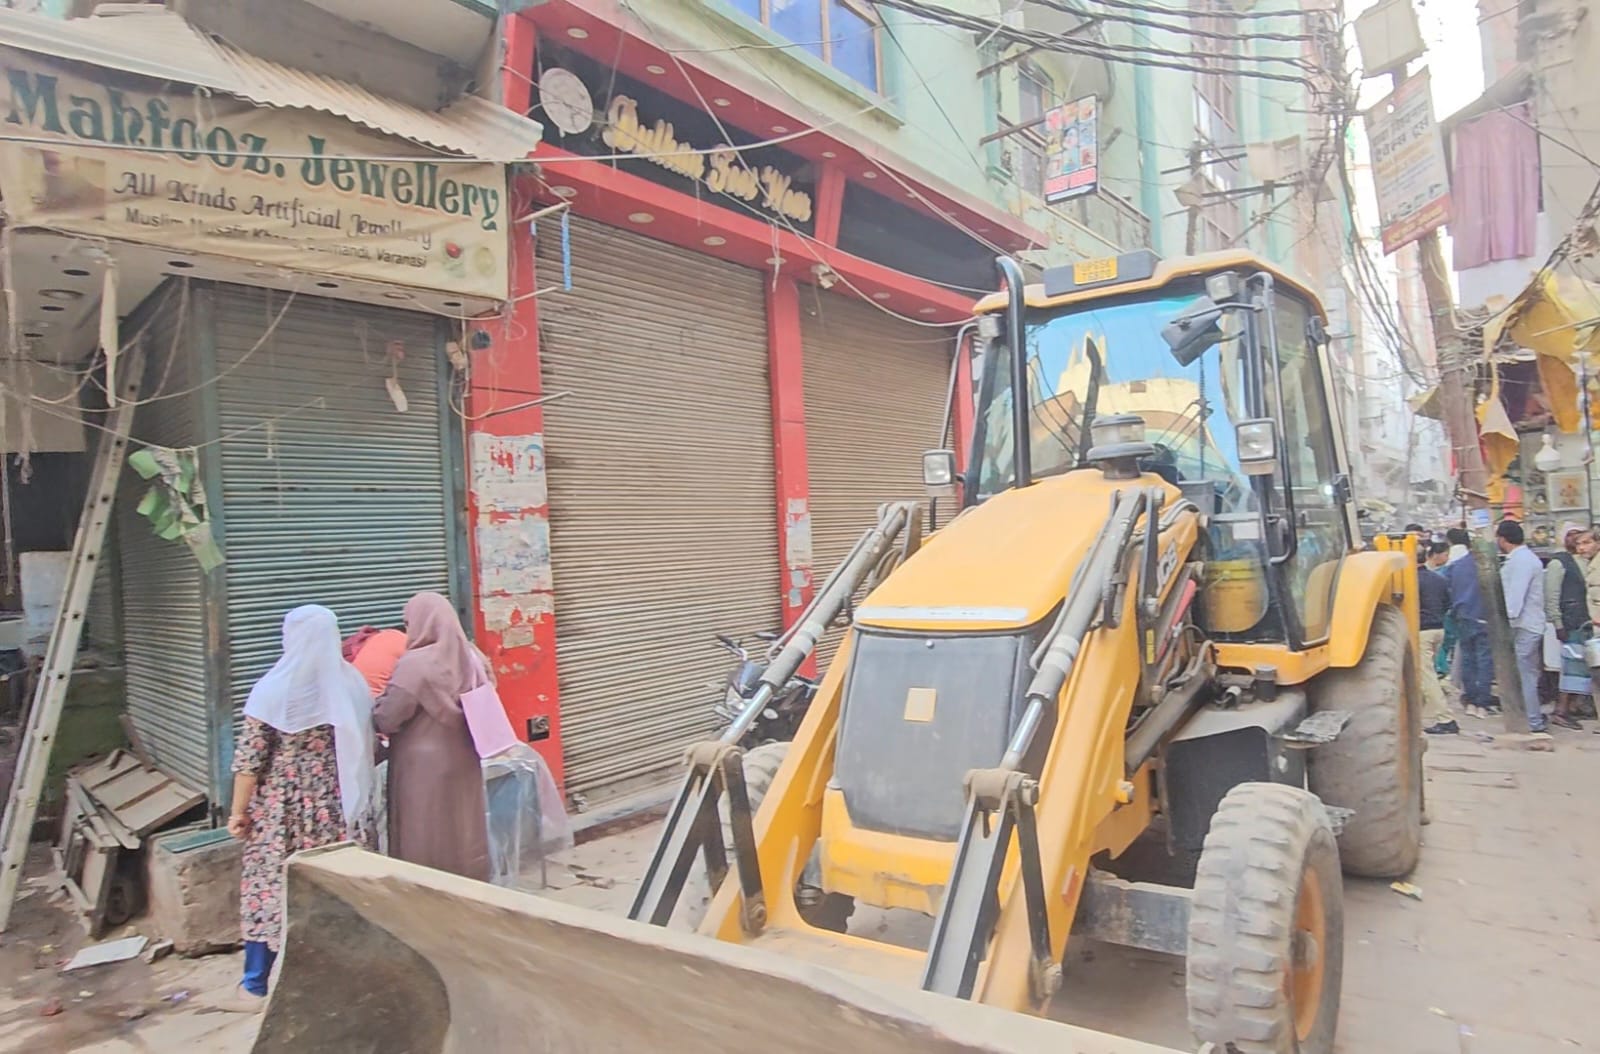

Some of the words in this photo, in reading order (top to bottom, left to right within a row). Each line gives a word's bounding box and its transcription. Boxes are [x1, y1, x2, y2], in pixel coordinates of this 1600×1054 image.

[113, 171, 156, 197] All
[166, 179, 238, 212] Kinds
[241, 194, 341, 230] Artificial
[300, 135, 500, 231] Jewellery
[376, 247, 428, 268] Varanasi
